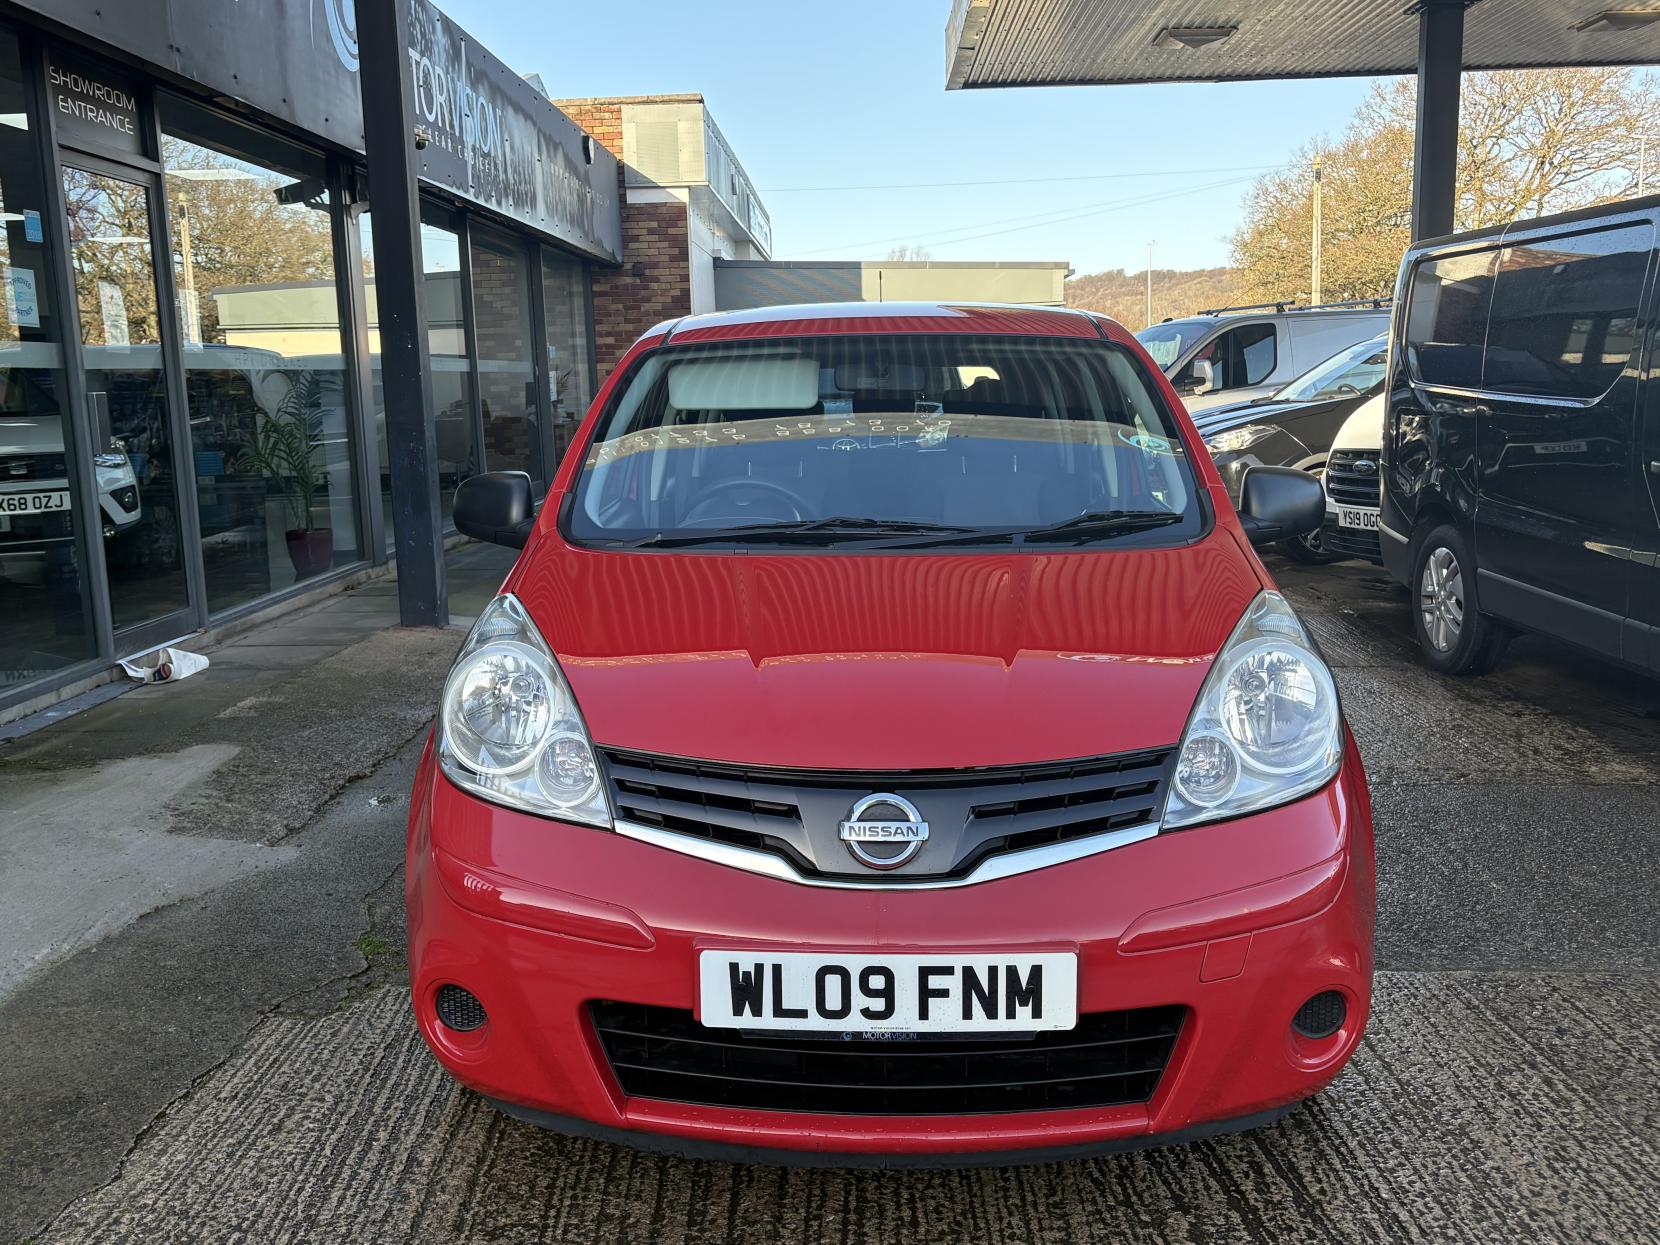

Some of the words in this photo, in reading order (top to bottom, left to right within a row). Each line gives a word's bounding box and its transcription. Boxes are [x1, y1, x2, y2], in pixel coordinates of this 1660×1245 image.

[49, 66, 136, 112] SHOWROOM
[58, 95, 134, 135] ENTRANCE
[33, 494, 64, 510] OZJ
[1342, 510, 1361, 526] YS19
[848, 825, 919, 838] NISSAN
[728, 962, 896, 1021] WL09
[918, 964, 1043, 1021] FNM
